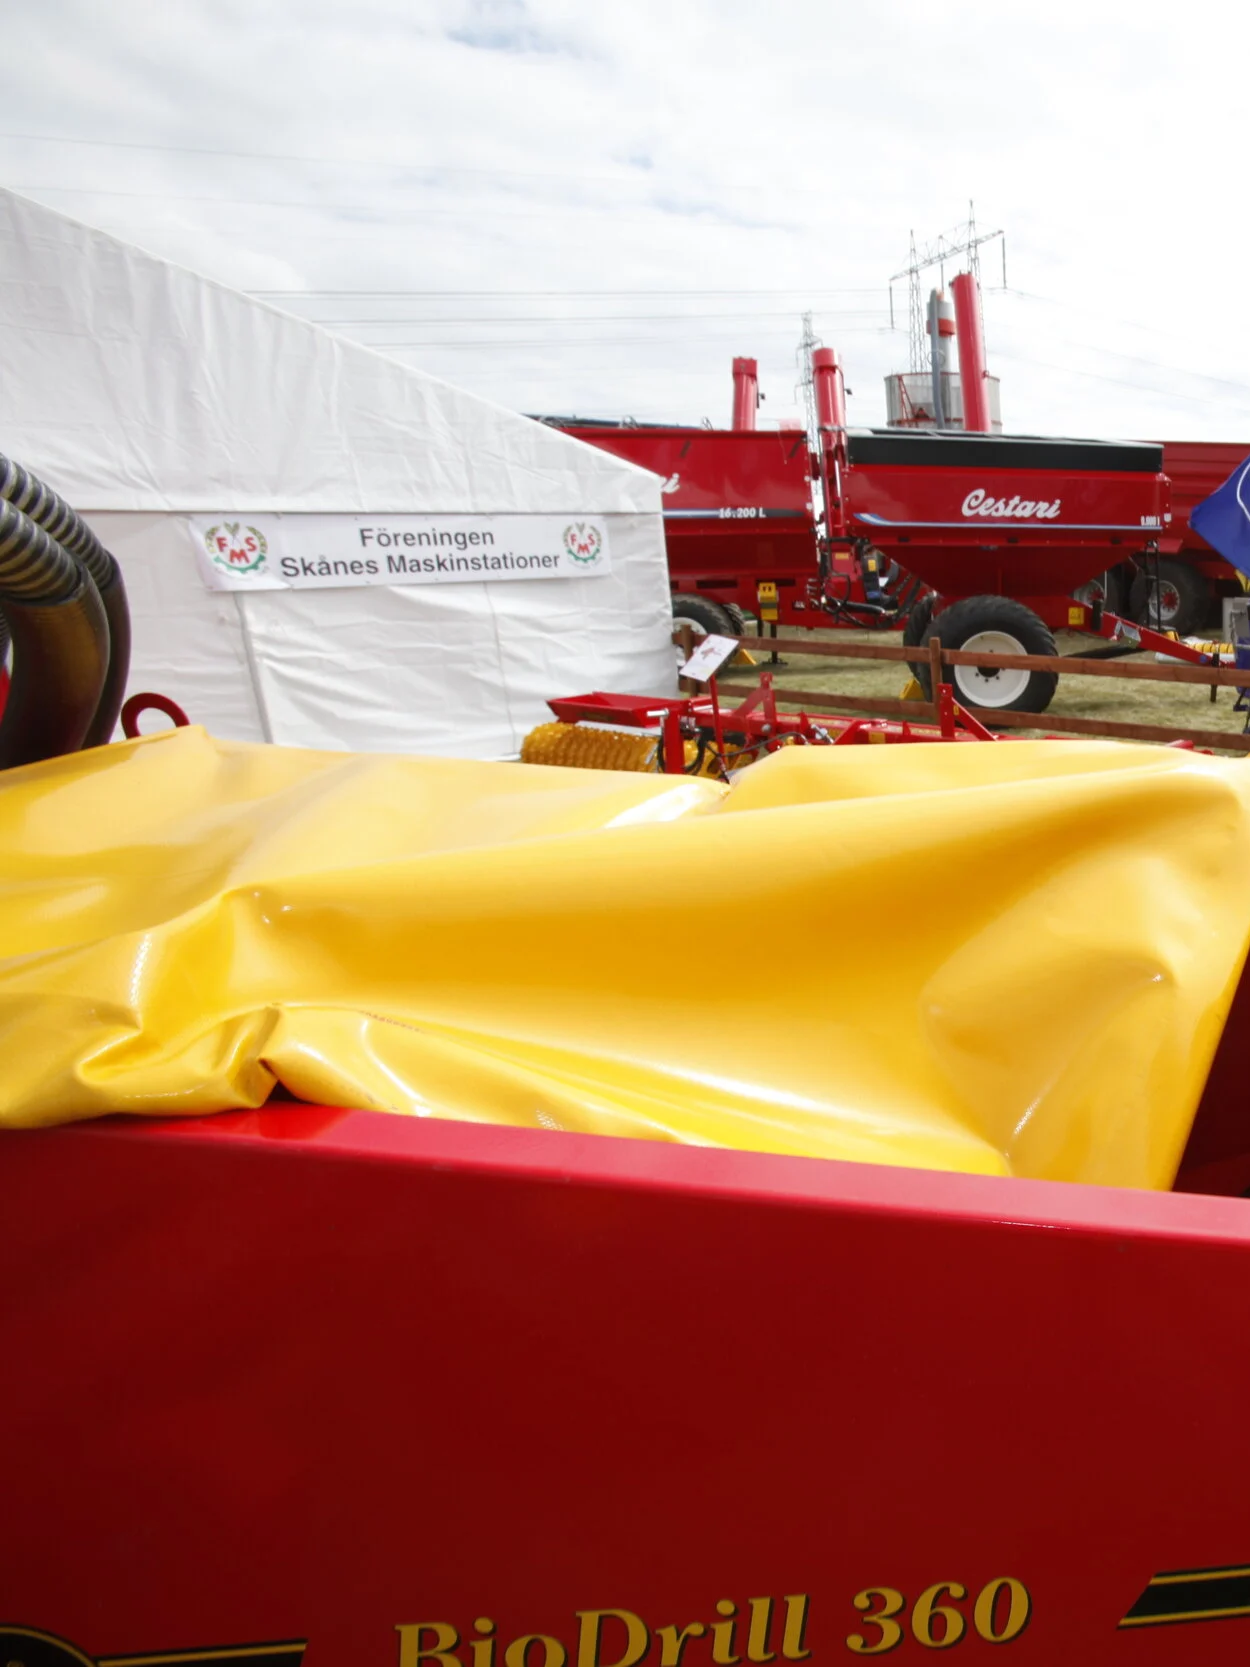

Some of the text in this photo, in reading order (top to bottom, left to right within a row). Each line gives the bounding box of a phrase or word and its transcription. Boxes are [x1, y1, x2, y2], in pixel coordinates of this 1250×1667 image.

[758, 507, 767, 518] L
[961, 487, 1062, 519] Cestari
[359, 527, 495, 550] Föreningen
[280, 552, 560, 577] Skånes Maskinstationer
[394, 1576, 1032, 1667] BioDrill 360
